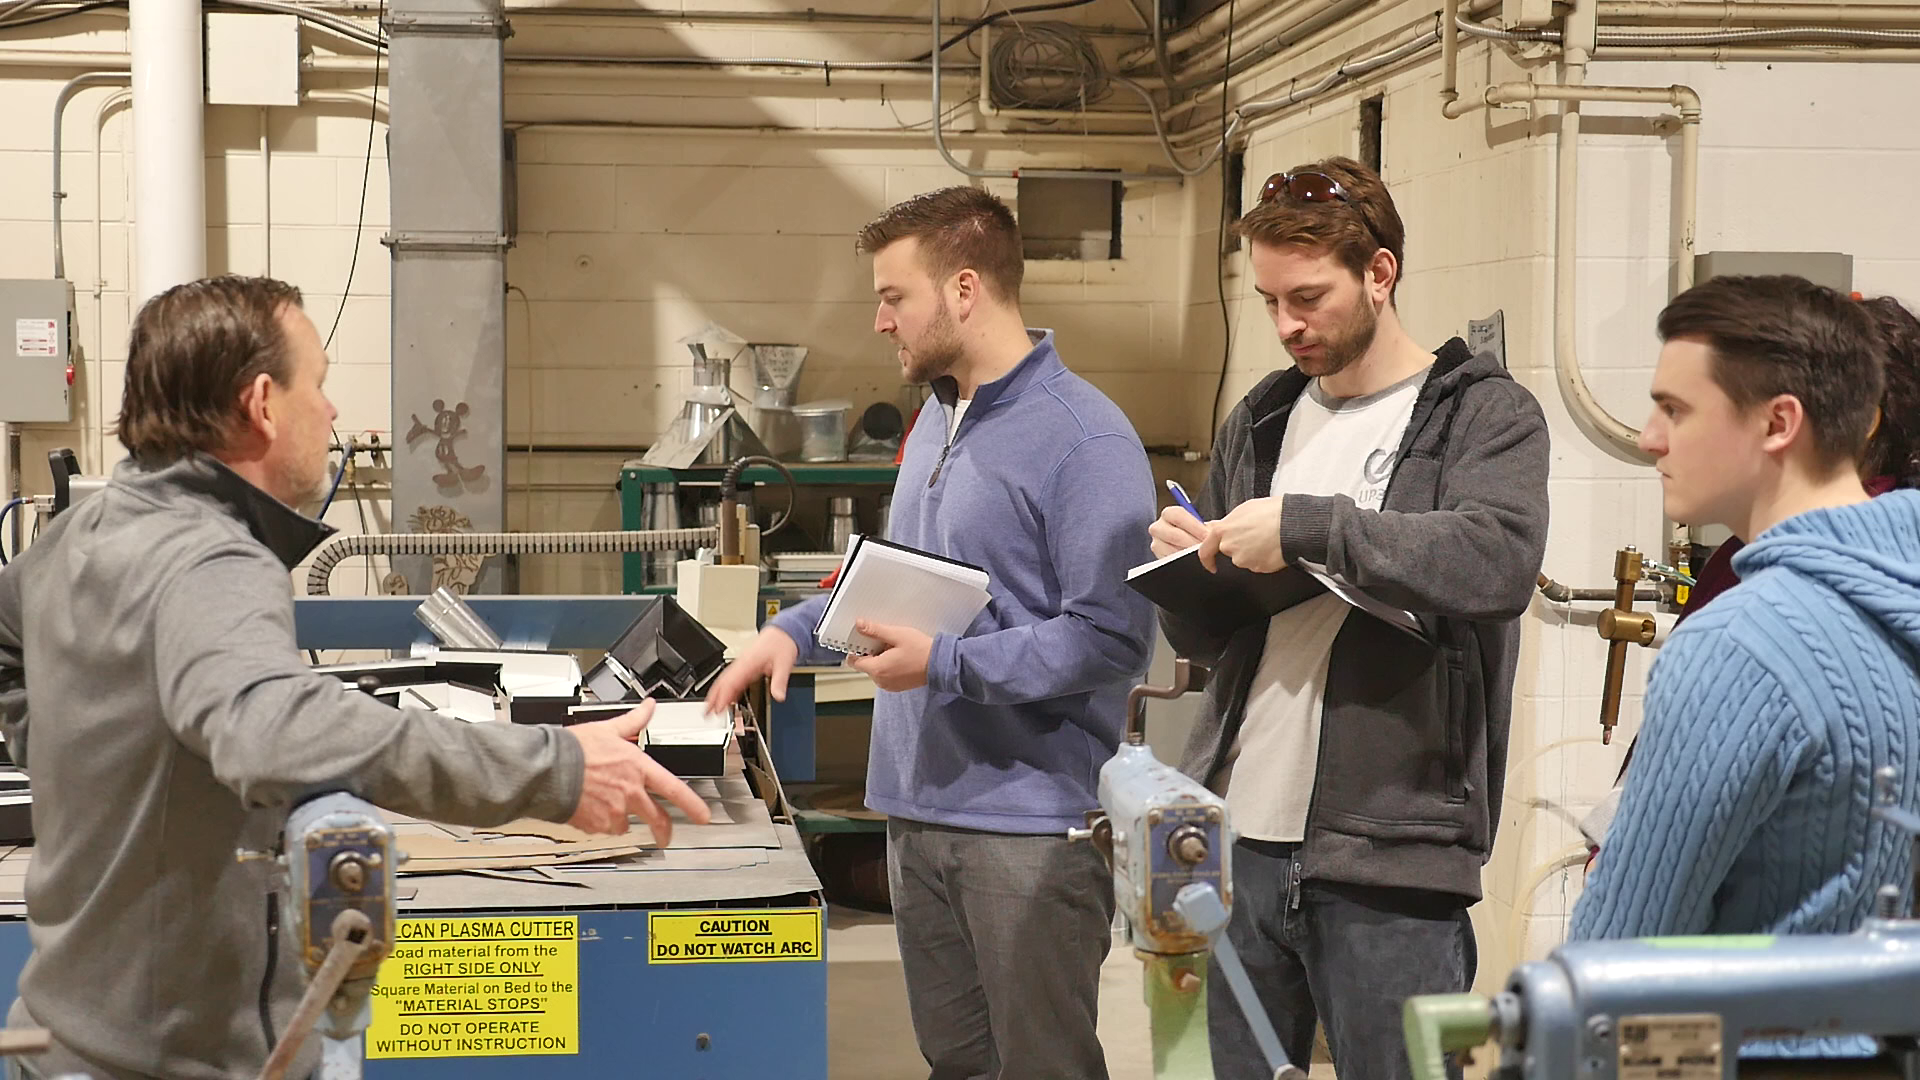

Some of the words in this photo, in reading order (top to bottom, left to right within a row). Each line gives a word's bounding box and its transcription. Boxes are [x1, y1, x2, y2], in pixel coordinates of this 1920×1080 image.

[441, 922, 505, 938] PLASMA
[510, 920, 574, 937] CUTTER
[700, 919, 769, 933] CAUTION
[429, 945, 490, 958] material
[495, 945, 529, 957] from
[534, 945, 558, 956] the
[657, 944, 680, 957] DO
[684, 943, 717, 956] NOT
[721, 942, 775, 955] WATCH
[780, 941, 813, 954] ARC
[404, 963, 453, 975] RIGHT
[458, 962, 495, 974] SIDE
[500, 961, 541, 973] ONLY
[371, 984, 420, 998] Square
[424, 982, 479, 995] Material
[483, 985, 500, 994] on
[504, 981, 530, 993] Bed
[534, 981, 548, 993] to
[552, 981, 573, 993] the
[395, 998, 483, 1012] "MATERIAL
[488, 997, 548, 1010] STOPS"
[400, 1023, 423, 1036] DO
[428, 1022, 461, 1035] NOT
[465, 1021, 539, 1034] OPERATE
[376, 1039, 452, 1052] WITHOUT
[457, 1037, 566, 1051] INSTRUCTION
